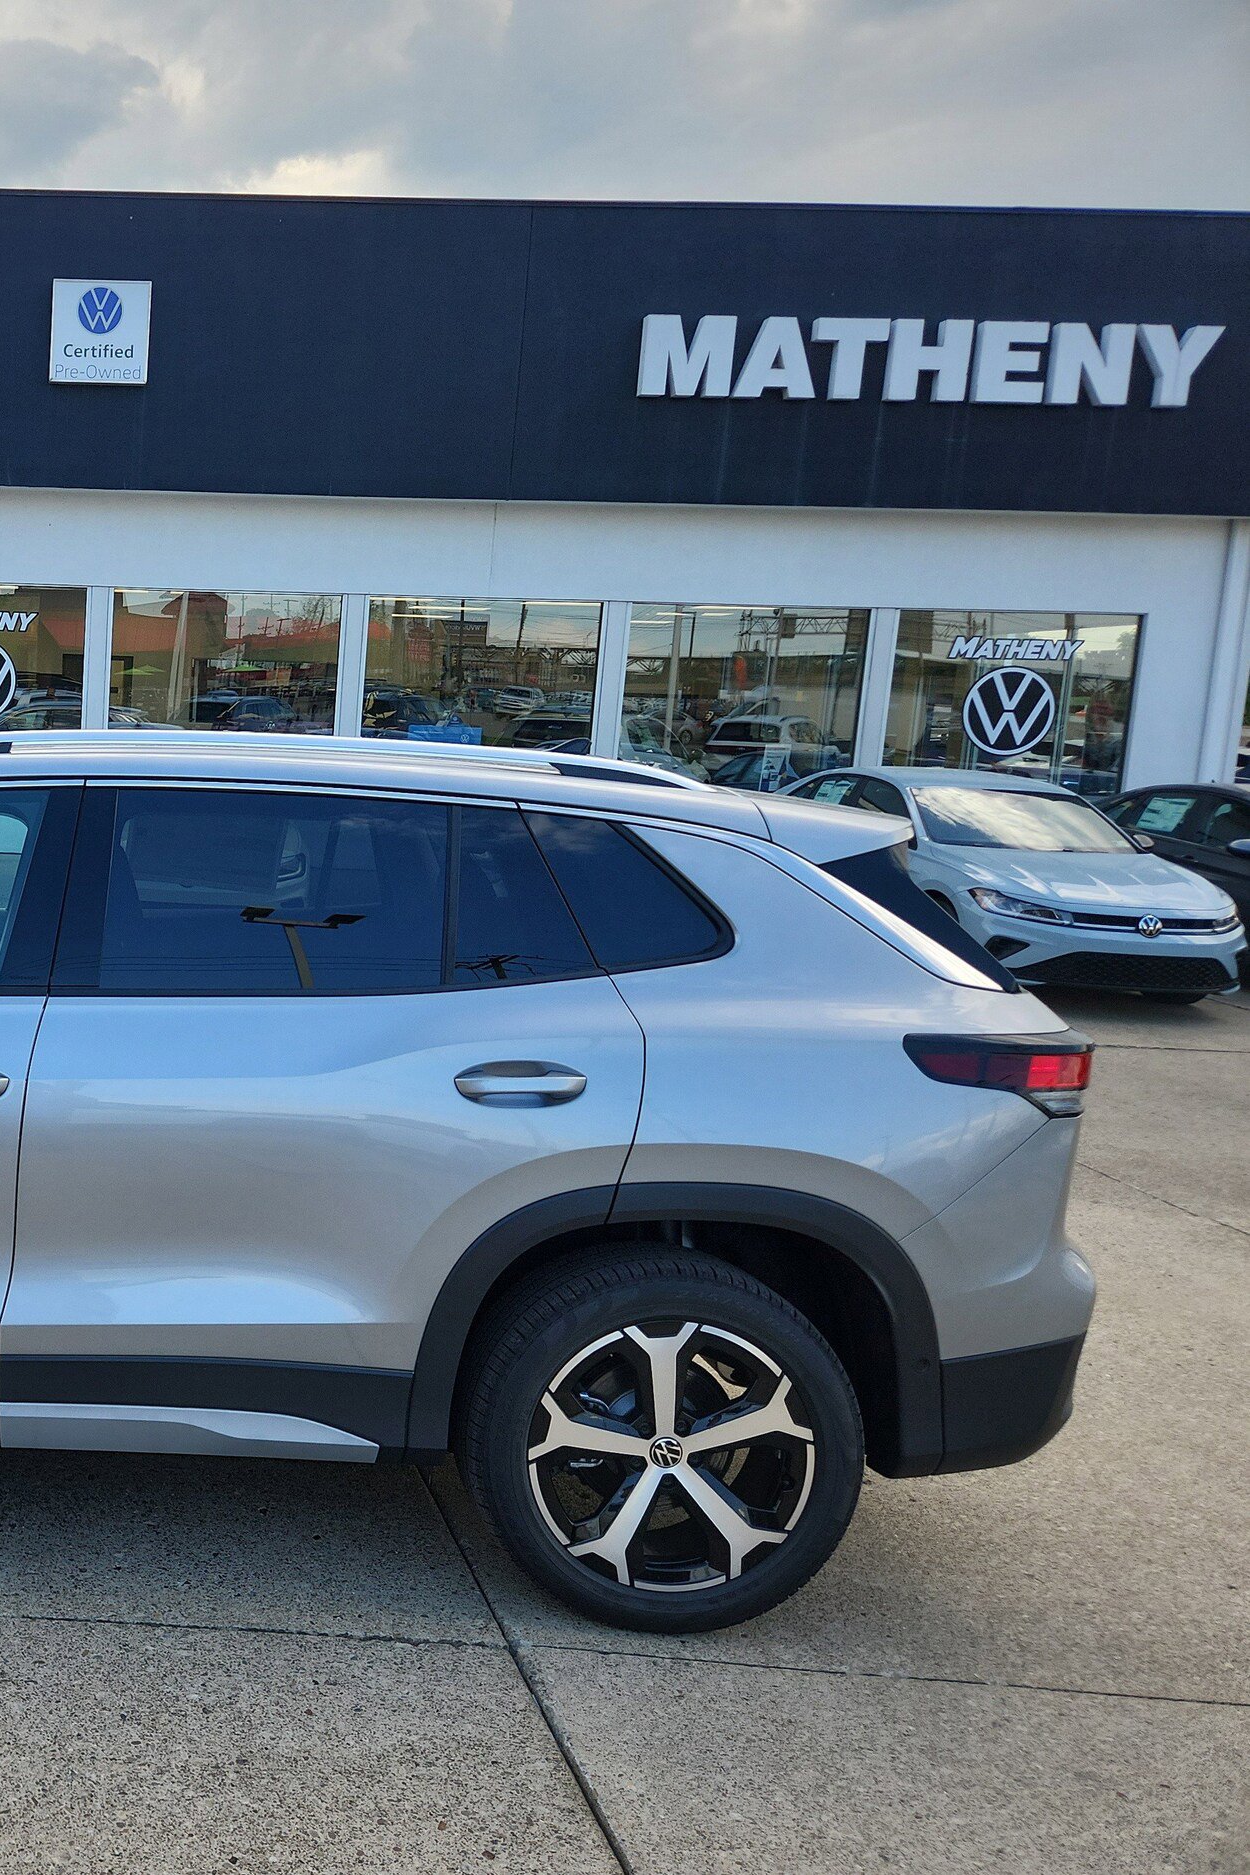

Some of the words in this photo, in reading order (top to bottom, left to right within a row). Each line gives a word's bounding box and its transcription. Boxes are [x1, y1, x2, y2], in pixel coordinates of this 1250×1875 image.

[78, 287, 122, 334] VW
[63, 343, 134, 359] Certified
[636, 314, 1227, 408] MATHENY
[54, 364, 142, 380] Pre-Owned
[947, 635, 1085, 661] MATHENY
[963, 666, 1055, 756] VW
